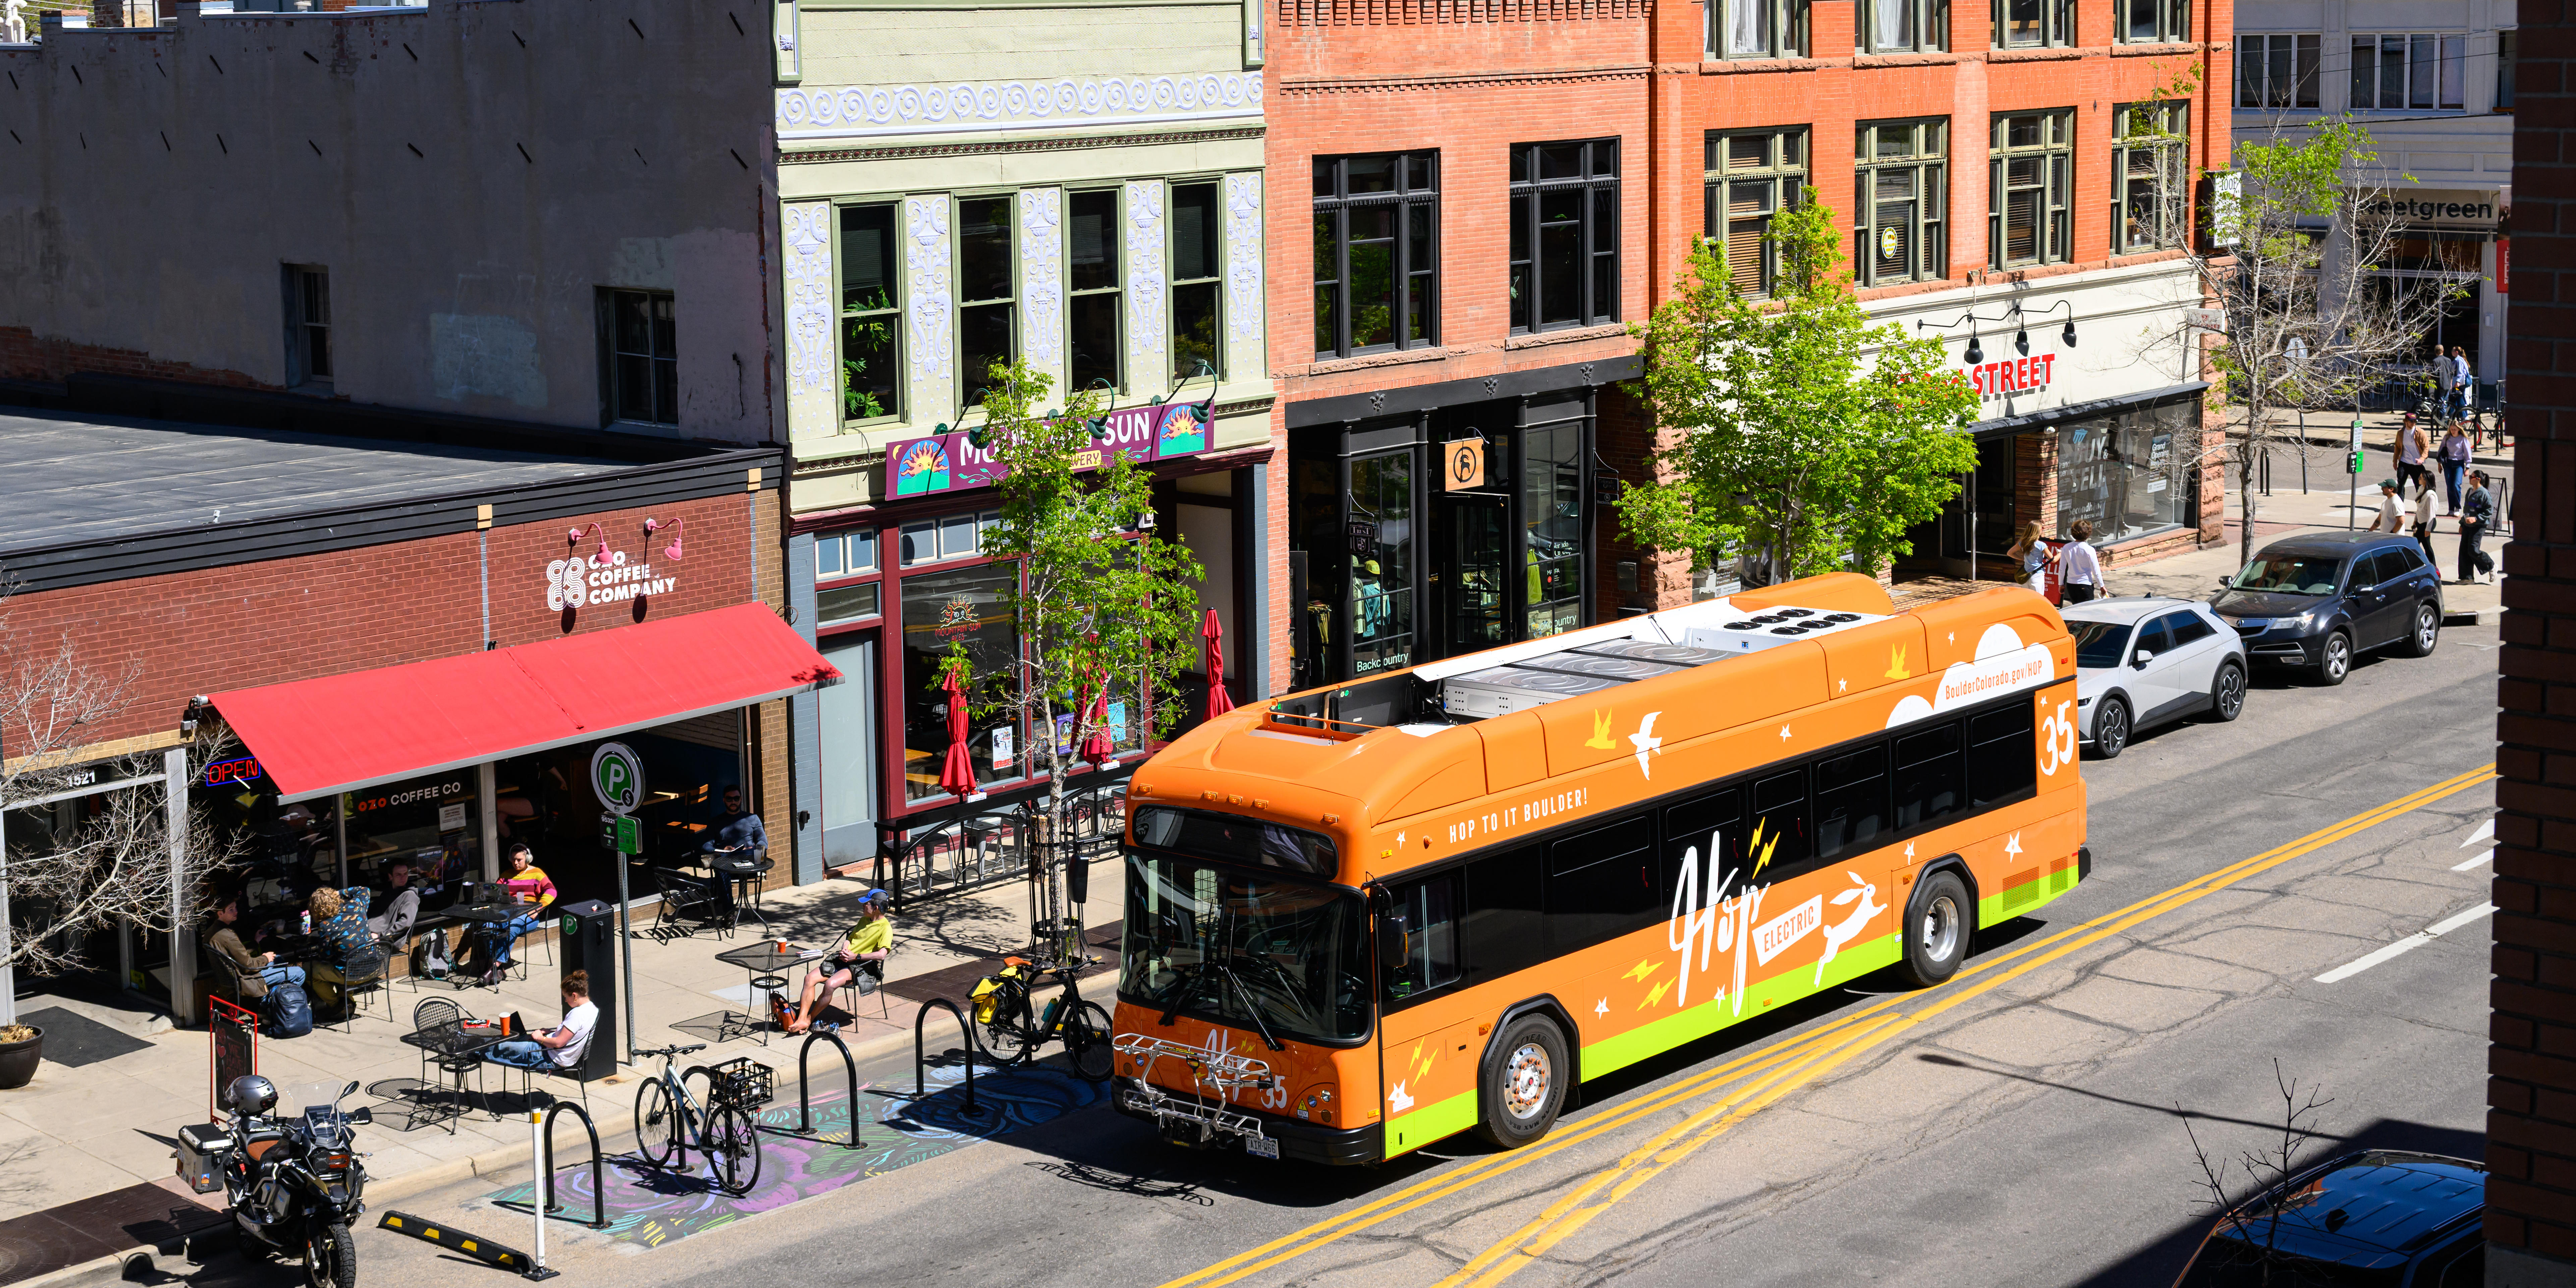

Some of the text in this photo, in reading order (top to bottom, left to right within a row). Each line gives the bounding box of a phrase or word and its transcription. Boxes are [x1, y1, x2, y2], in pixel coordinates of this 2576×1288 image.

[1972, 353, 2056, 395] STREET
[1101, 411, 1150, 446] SUN
[2074, 436, 2109, 465] BUY &
[2151, 450, 2169, 460] Opening
[2152, 442, 2166, 451] Grand
[2059, 468, 2074, 479] pening
[1351, 526, 1370, 535] TRUST
[589, 564, 650, 587] COFFEE
[589, 577, 676, 604] COMPANY
[935, 622, 981, 637] MOUNTAIN SUN
[1531, 615, 1577, 632] Backcountry
[1357, 653, 1408, 672] Backcountry
[1946, 660, 2042, 700] BoulderColorado.gov/HOP
[2040, 700, 2074, 776] 35
[67, 772, 95, 787] 1521
[209, 759, 257, 783] OPEN
[608, 763, 625, 792] P
[391, 786, 439, 805] COFFEE
[443, 782, 460, 794] CO
[1450, 787, 1587, 843] HOP TO IT BOULDER!
[566, 918, 573, 931] P
[1670, 830, 1771, 1017] Hop
[1764, 906, 1814, 953] ELECTRIC
[229, 1043, 240, 1058] WE
[1504, 1033, 1547, 1070] GOODYEAR
[1260, 1075, 1287, 1109] 35
[1542, 1087, 1559, 1121] URBAN
[1524, 1119, 1540, 1131] MAX
